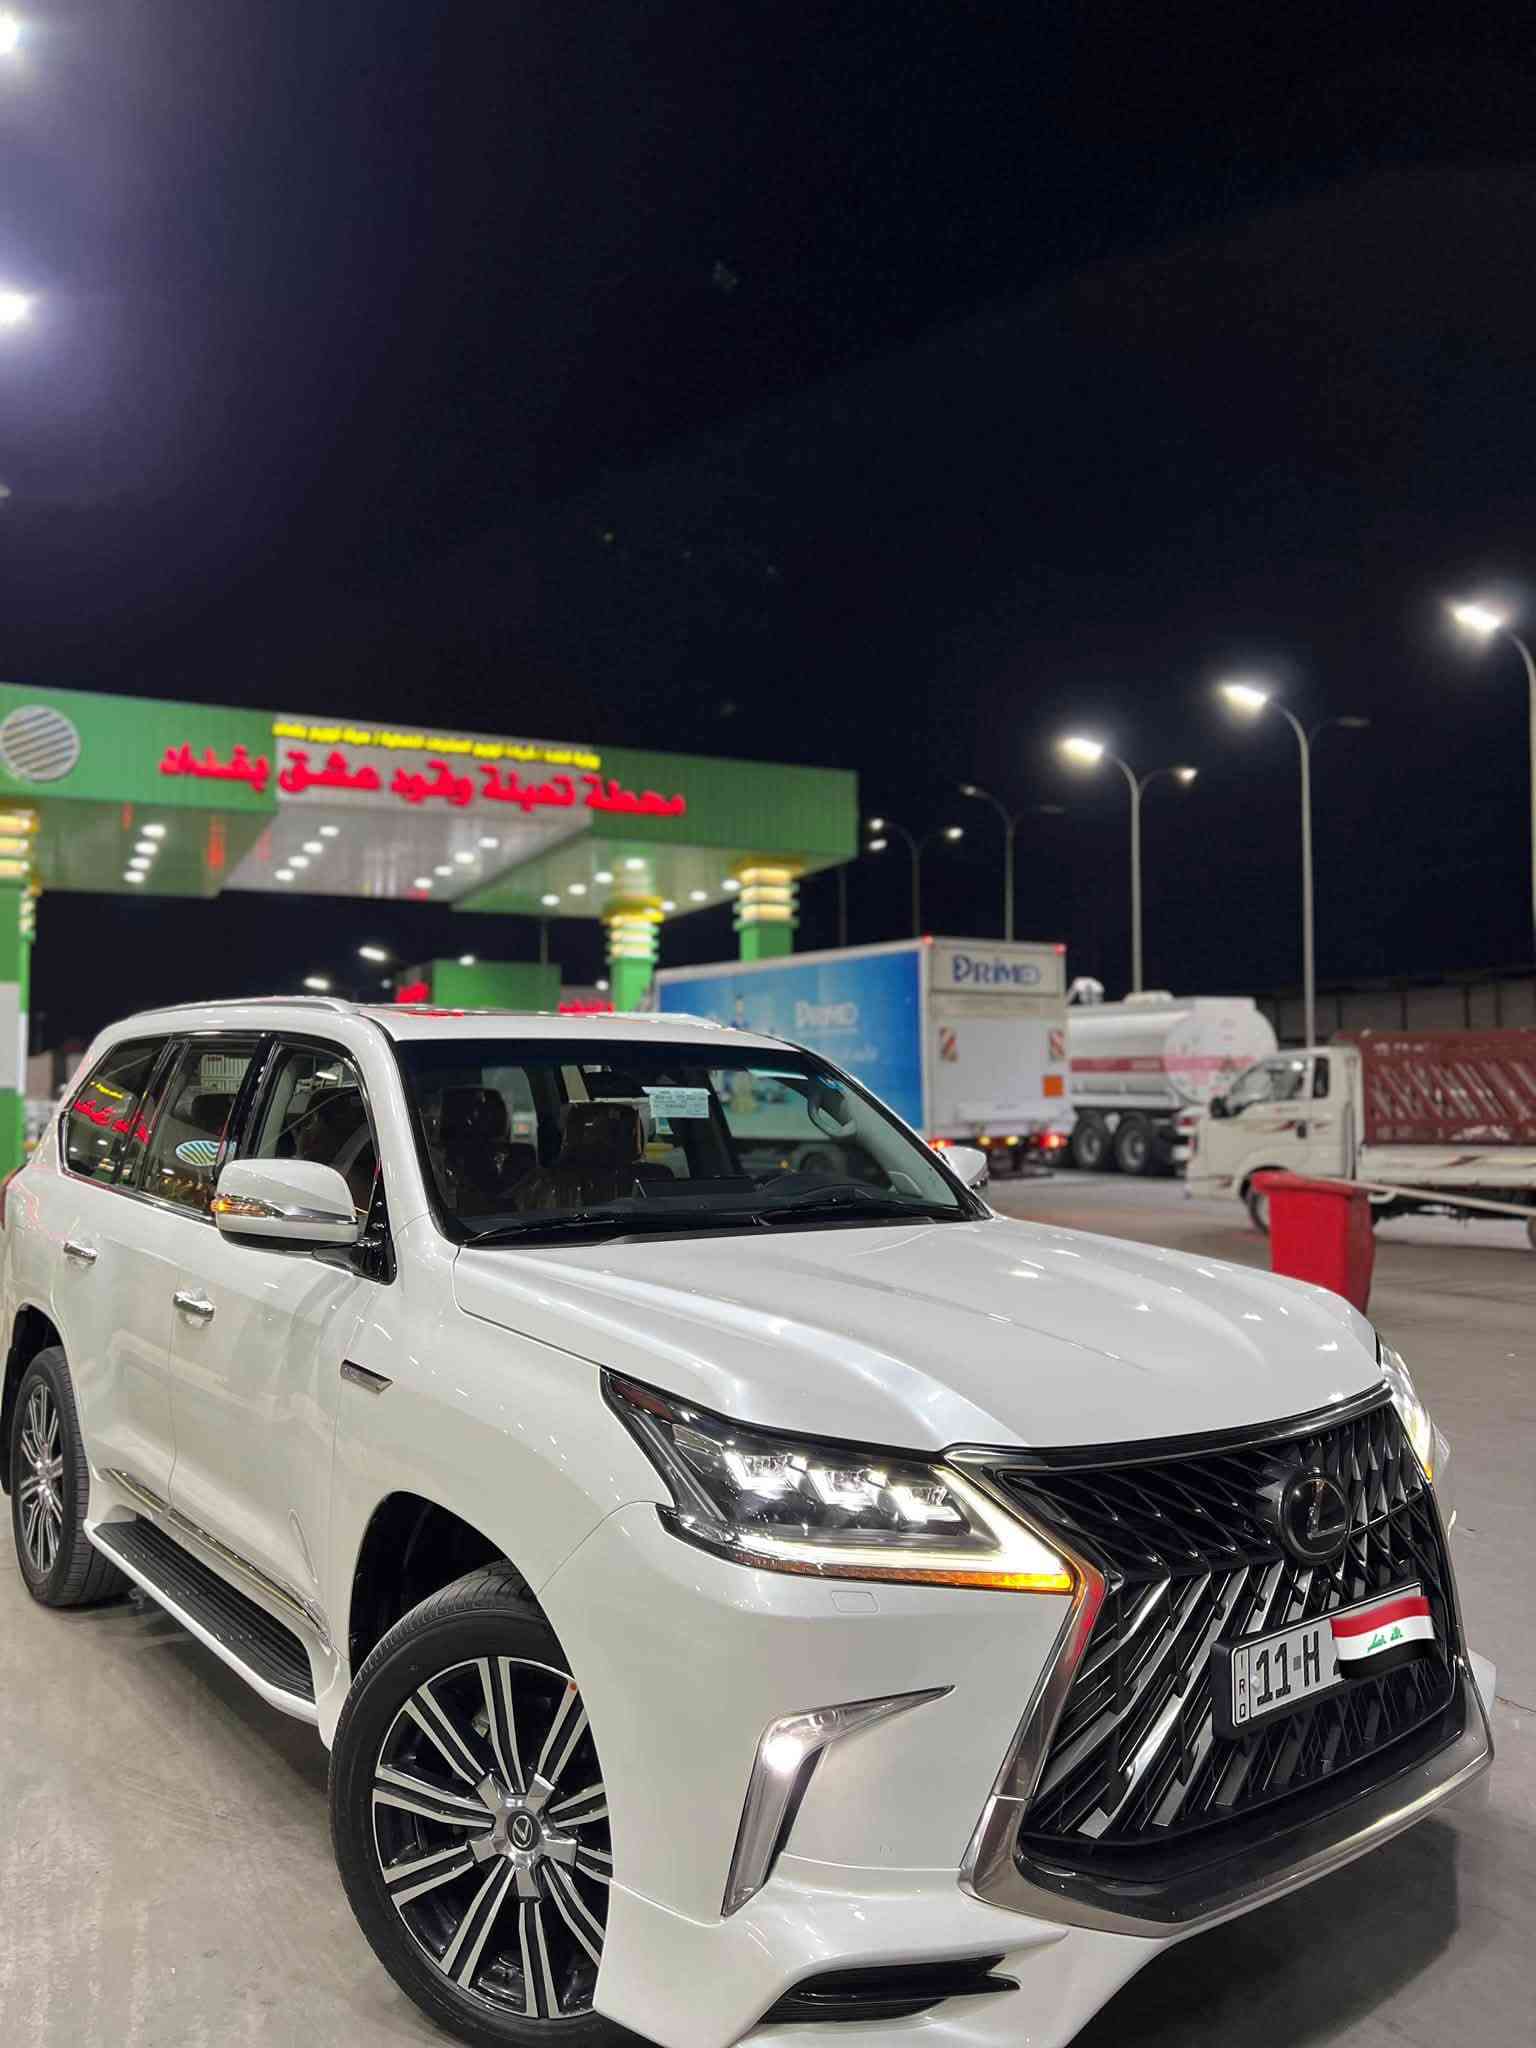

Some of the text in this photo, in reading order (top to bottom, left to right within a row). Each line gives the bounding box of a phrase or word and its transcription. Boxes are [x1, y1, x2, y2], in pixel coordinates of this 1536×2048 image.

[159, 742, 271, 793] بغداد
[388, 758, 477, 808] وقود
[480, 762, 578, 815] تعبئة
[579, 773, 686, 817] محطة
